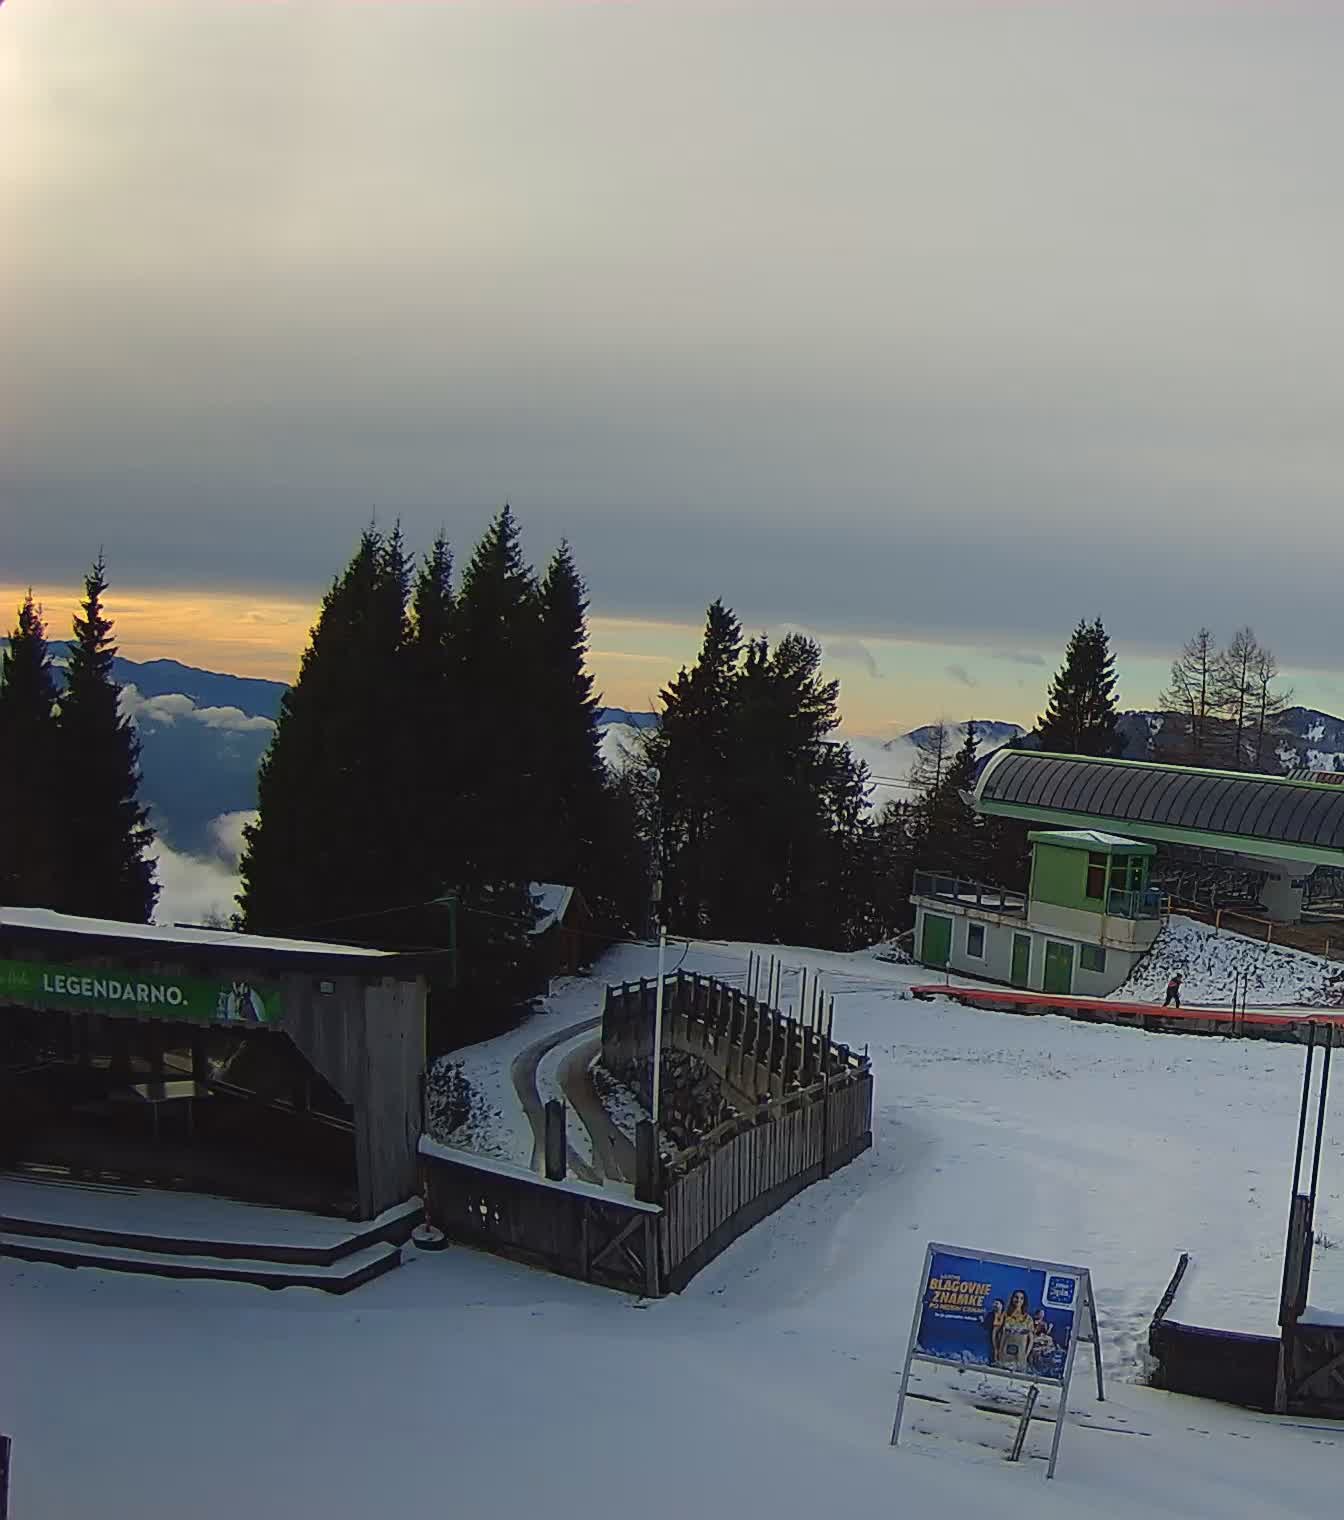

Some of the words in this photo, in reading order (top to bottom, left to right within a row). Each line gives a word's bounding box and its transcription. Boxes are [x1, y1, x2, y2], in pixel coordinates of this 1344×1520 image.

[43, 973, 188, 1006] LEGENDARNO.
[929, 1278, 992, 1296] BLAGOVNE
[932, 1290, 985, 1307] ZNAMKE
